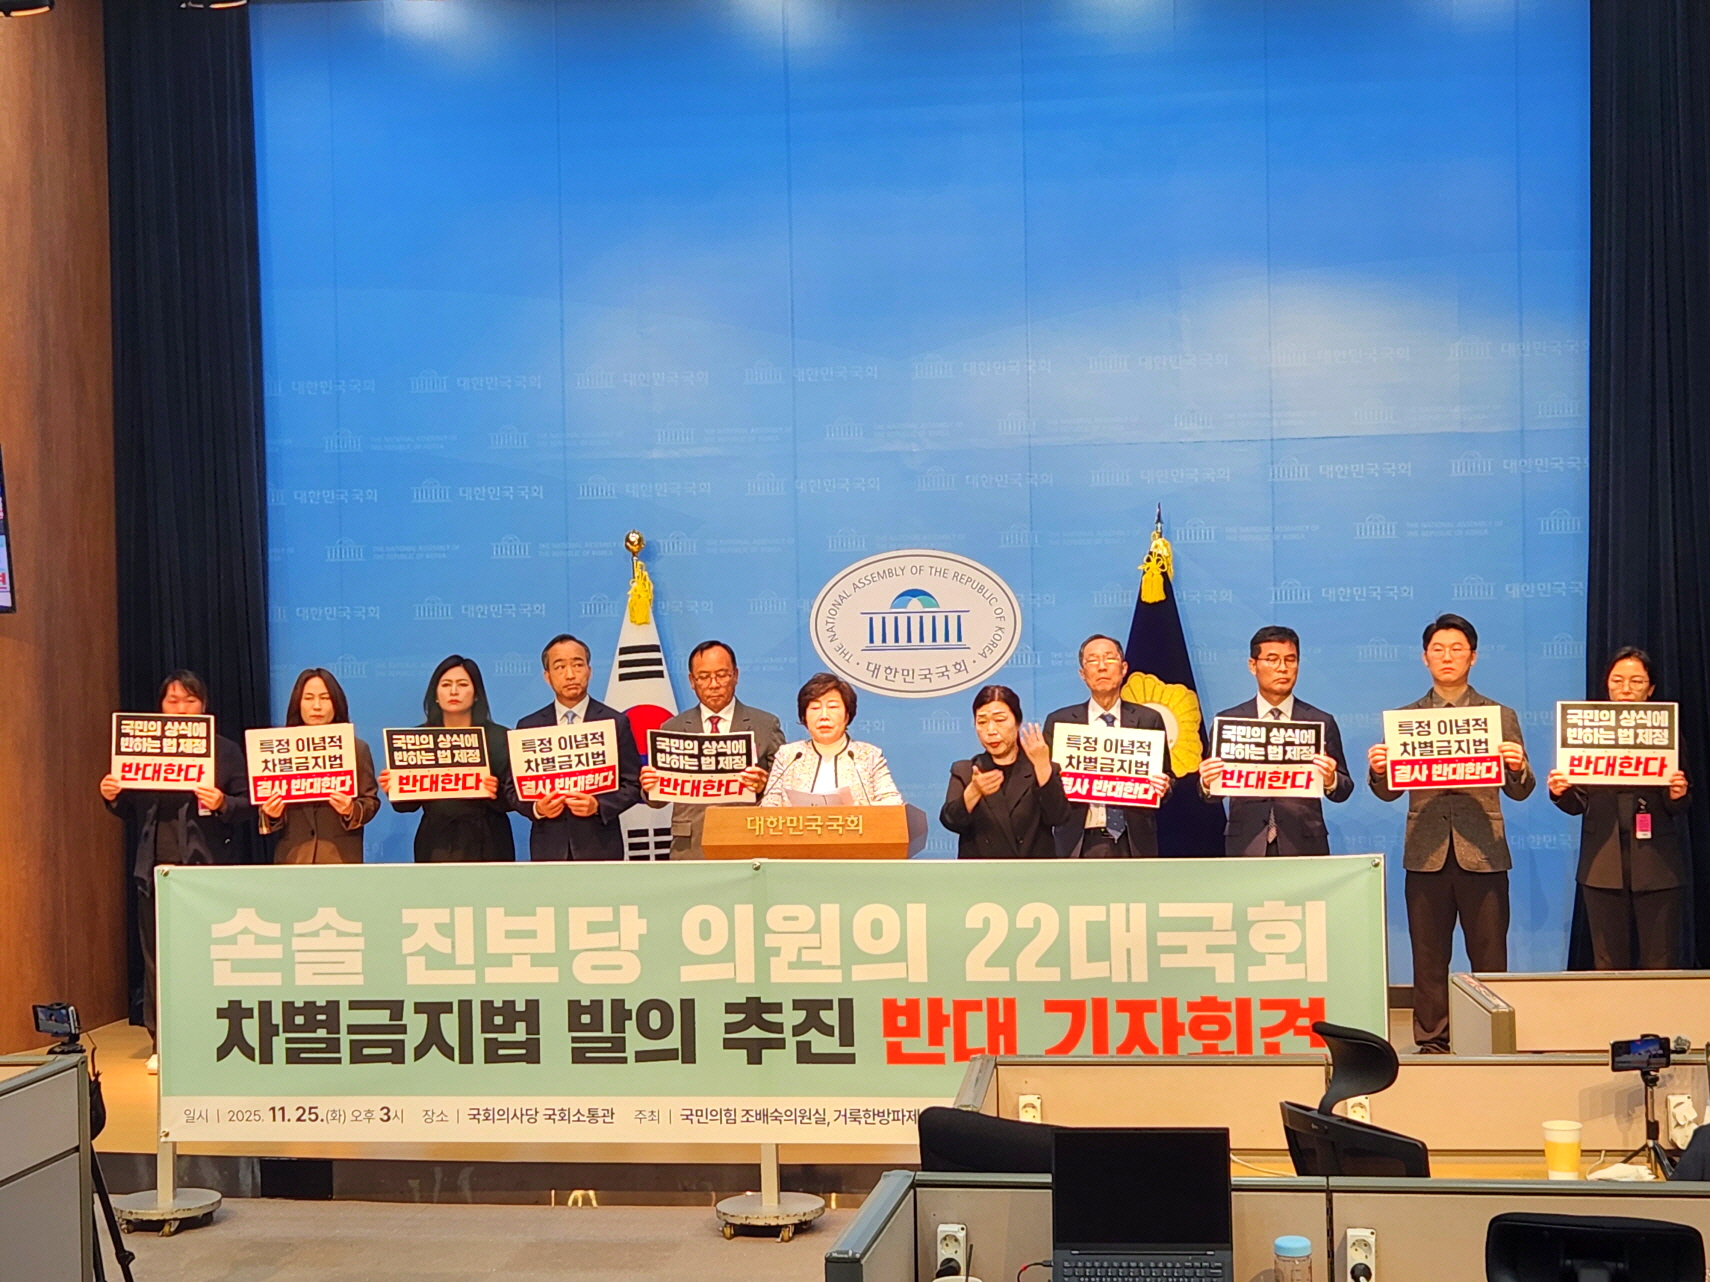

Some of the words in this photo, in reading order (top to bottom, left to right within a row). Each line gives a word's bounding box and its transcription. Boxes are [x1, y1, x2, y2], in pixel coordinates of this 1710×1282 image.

[1319, 461, 1412, 478] 대한민국국회
[294, 489, 378, 504] 대한민국국회
[459, 485, 544, 501] 대한민국국회
[625, 481, 711, 498] 대한민국국회
[852, 565, 906, 593] ASSEMBLY
[910, 565, 925, 576] OF
[928, 565, 950, 579] THE
[952, 571, 999, 606] REPUBLIC
[1322, 585, 1414, 602] 대한민국국회
[296, 605, 380, 621] 대한민국국회
[461, 602, 546, 618] 대한민국국회
[825, 589, 852, 644] NATIONAL
[993, 607, 1006, 622] OF
[978, 625, 1006, 660] KOREA
[834, 643, 853, 663] THE
[866, 659, 970, 684] 대한민국국회
[1398, 720, 1431, 737] 특정
[1437, 717, 1488, 735] 이념적
[1566, 709, 1616, 726] 국민의
[1619, 710, 1669, 727] 상식에
[121, 720, 162, 736] 국민의
[164, 721, 207, 737] 상식에
[1222, 725, 1266, 743] 국민의
[1269, 728, 1316, 744] 상식에
[1566, 727, 1615, 745] 반하는
[1618, 728, 1634, 745] 법
[1636, 729, 1669, 745] 제정
[120, 736, 161, 753] 반하는
[162, 737, 177, 753] 법
[178, 738, 207, 754] 제정
[259, 738, 290, 754] 특정
[296, 735, 343, 752] 이념적
[392, 734, 434, 749] 국민의
[437, 734, 479, 748] 상식에
[521, 737, 553, 754] 특정
[558, 731, 605, 750] 이념적
[656, 737, 698, 754] 국민의
[702, 739, 746, 755] 상식에
[1066, 734, 1098, 752] 특정
[1103, 738, 1152, 756] 이념적
[1400, 738, 1489, 757] 차별금지법
[394, 750, 435, 765] 반하는
[436, 749, 452, 764] 법
[453, 749, 481, 763] 제정
[524, 750, 606, 773] 차별금지법
[656, 752, 699, 770] 반하는
[700, 756, 716, 770] 법
[717, 755, 747, 770] 제정
[1221, 743, 1265, 760] 반하는
[1267, 745, 1284, 761] 법
[1285, 745, 1316, 760] 제정
[121, 762, 206, 783] 반대한다
[261, 754, 343, 773] 차별금지법
[1065, 754, 1150, 776] 차별금지법
[1394, 764, 1429, 783] 결사
[1432, 761, 1499, 781] 반대한다
[1568, 755, 1668, 777] 반대한다
[257, 779, 288, 797] 결사
[291, 775, 352, 795] 반대한다
[398, 772, 483, 793] 반대한다
[521, 779, 552, 796] 결사
[555, 770, 614, 793] 반대한다
[659, 776, 746, 797] 반대한다
[1221, 770, 1314, 789] 반대한다
[1091, 779, 1155, 800] 반대한다
[746, 814, 864, 836] 대한민국국회
[209, 906, 365, 987] 손솔
[400, 903, 647, 986] 진보당
[680, 902, 928, 985] 의원의
[964, 900, 1328, 983] 22대국회
[216, 998, 542, 1066] 차별금지법
[567, 997, 697, 1066] 발의
[722, 996, 856, 1066] 추진
[882, 996, 1018, 1066] 반대
[1043, 995, 1328, 1057] 기자회견
[183, 1108, 209, 1124] 일시
[227, 1109, 265, 1123] 2025.
[268, 1106, 291, 1123] 11.
[350, 1109, 376, 1124] 오후
[379, 1106, 404, 1124] 3시
[422, 1108, 449, 1124] 장소
[467, 1107, 539, 1125] 국회의사당
[543, 1107, 615, 1125] 국회소통관
[634, 1108, 661, 1125] 주최
[680, 1107, 737, 1125] 국민의힘
[740, 1107, 831, 1127] 조배숙의원실,
[833, 1107, 920, 1126] 거룩한방파제
